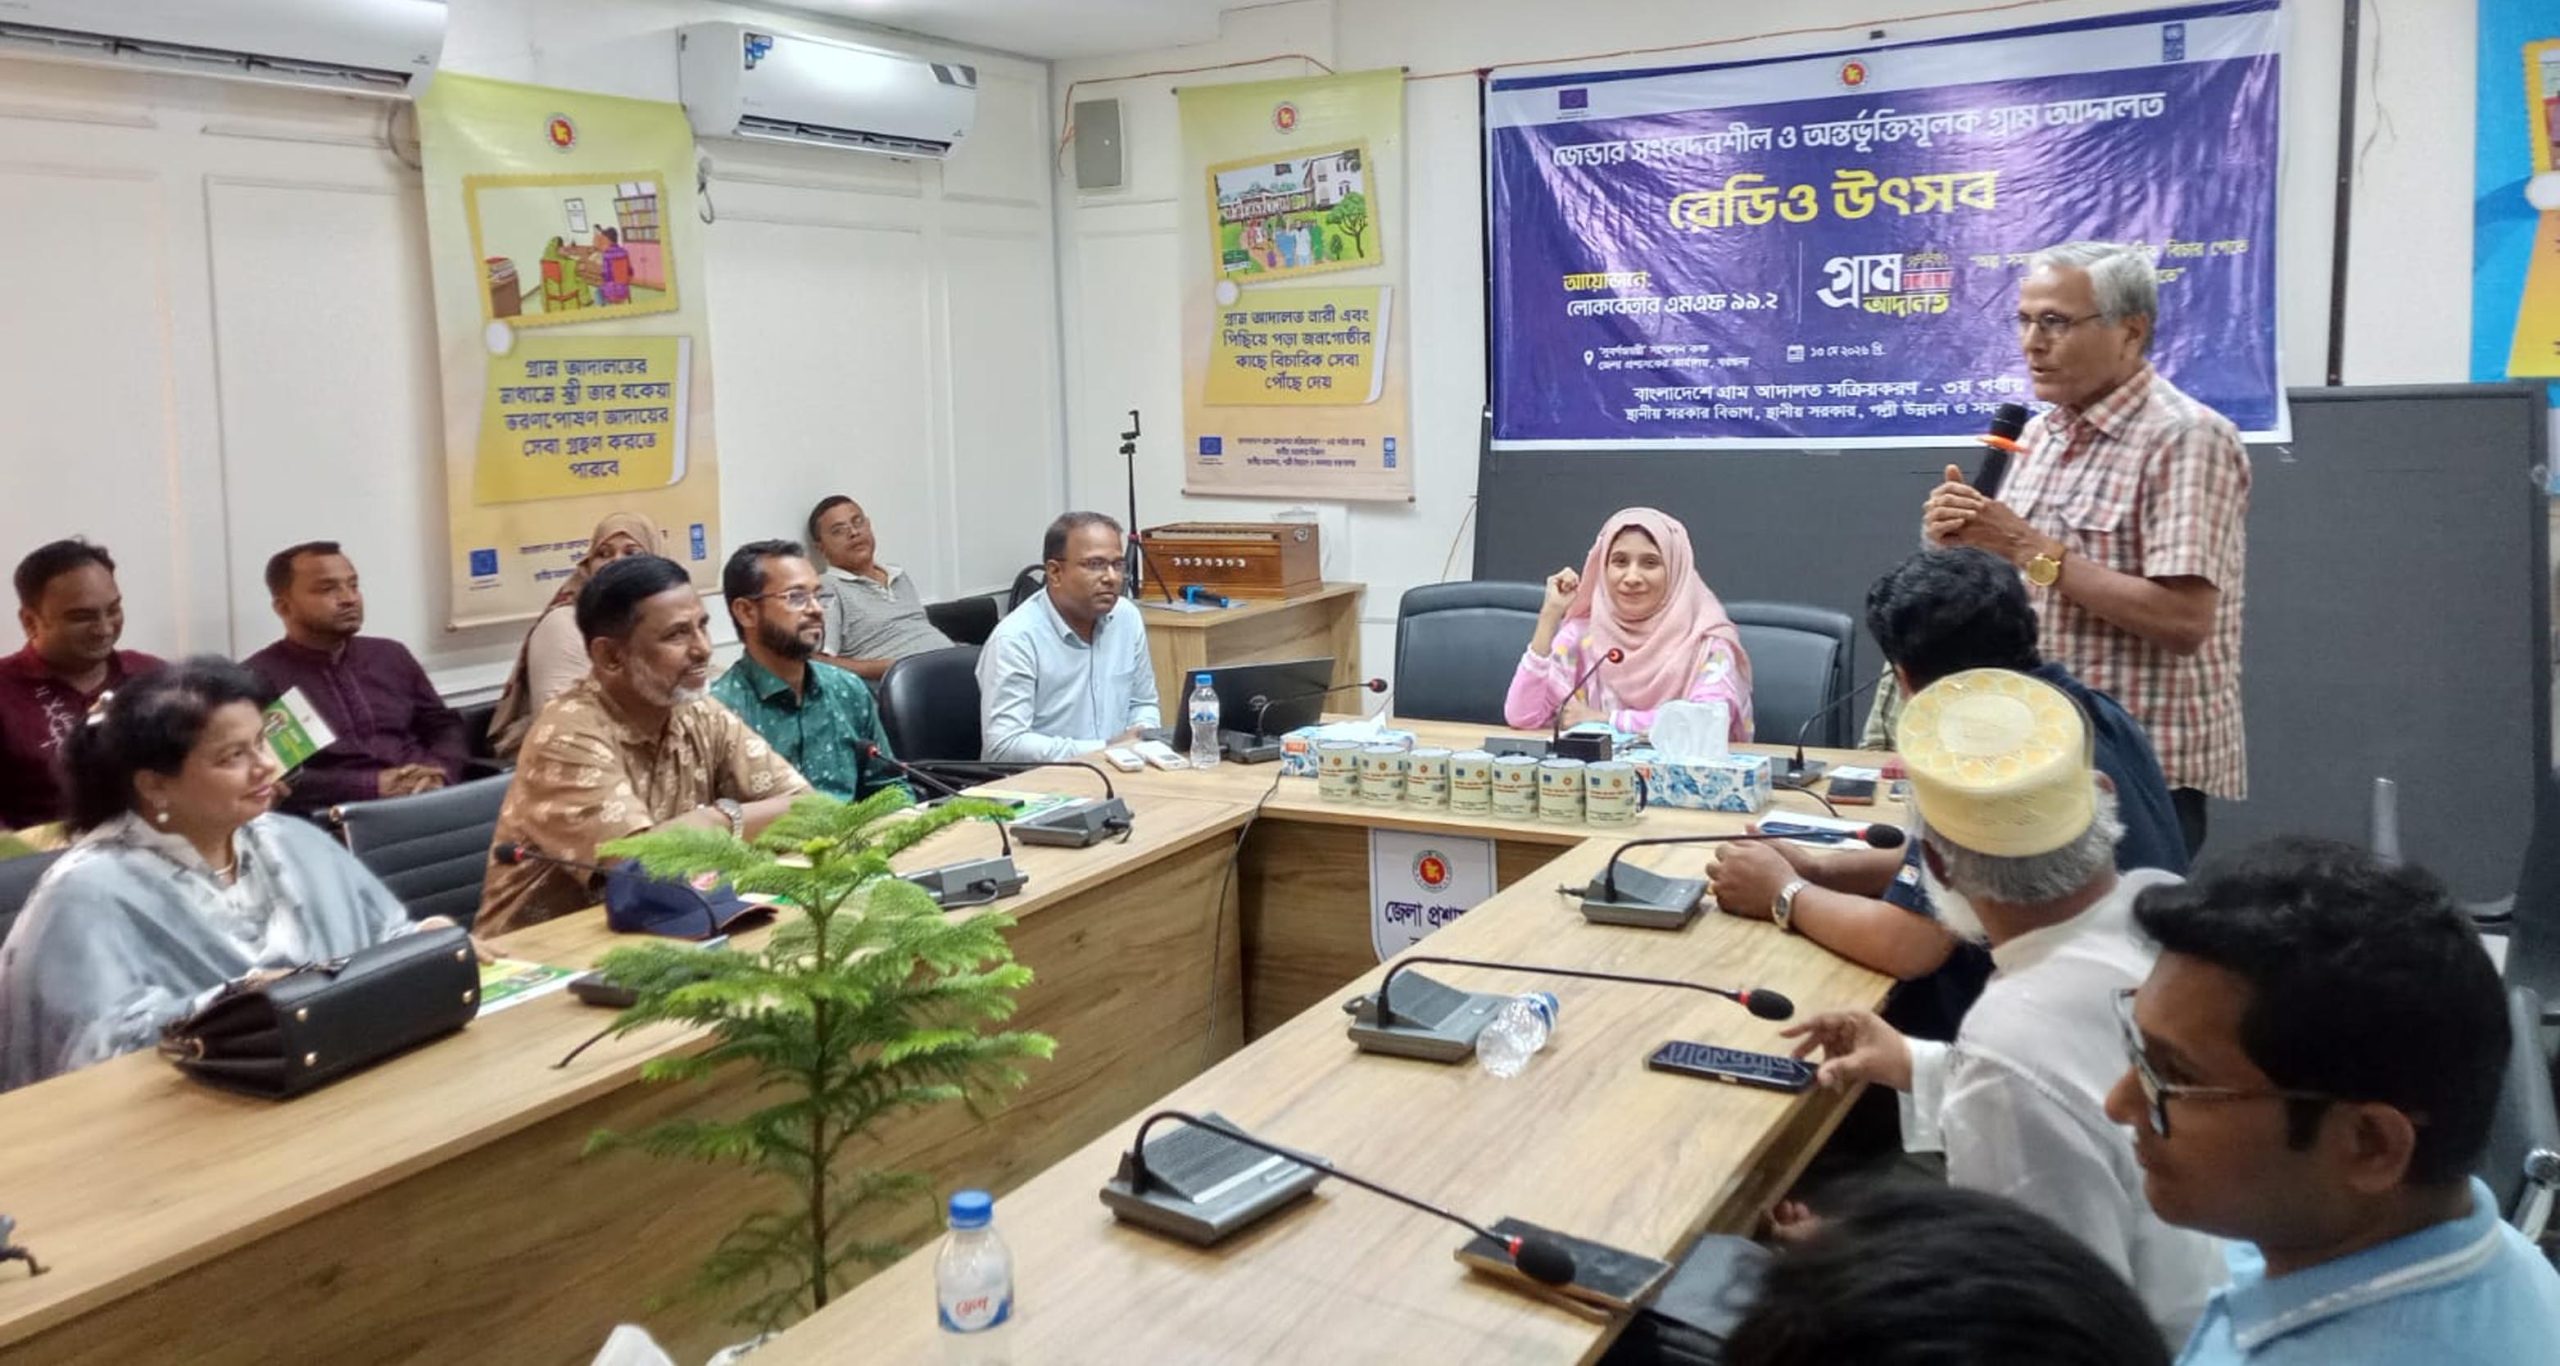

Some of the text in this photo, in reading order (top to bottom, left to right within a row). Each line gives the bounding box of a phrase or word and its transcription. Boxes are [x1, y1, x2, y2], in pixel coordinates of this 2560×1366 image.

[1553, 140, 1625, 166] জেন্ডার
[1630, 121, 1772, 161] সংবেদনশীল
[1778, 126, 1797, 148] ও
[1988, 103, 2039, 137] গ্রাম
[2044, 92, 2167, 126] আদালত
[1669, 169, 2001, 233] রেডিও উৎসব
[1563, 271, 1652, 293] আয়োজনে:
[1816, 254, 1903, 308] গ্রাম
[1252, 311, 1305, 325] আদালত
[1308, 304, 1335, 322] নারী
[1341, 309, 1369, 322] এবং
[1567, 291, 1778, 317] লোকবেতার এমএফ ৯৯.২
[1863, 292, 1951, 318] আদালত
[1223, 326, 1370, 348] পিছিয়ে পড়া জনগোষ্ঠীর
[526, 358, 648, 379] গ্রাম আদালতের
[1235, 350, 1359, 370] কাছে বিচারিক সেবা
[588, 385, 616, 401] তার
[621, 382, 671, 400] বকেয়া
[1307, 376, 1332, 389] দেয়
[1632, 385, 1713, 402] বাংলাদেশে
[1716, 385, 1749, 400] গ্রাম
[1753, 383, 1822, 399] আদালত
[1828, 378, 1921, 398] সক্রিয়করণ
[1941, 380, 1972, 395] ৩য়
[503, 407, 669, 431] ভরণপোষণ আদায়ের
[1624, 404, 1661, 422] স্থানীয়
[1665, 406, 1710, 420] সরকার
[1765, 403, 1804, 422] স্থানীয়
[1903, 400, 1948, 418] উন্নয়ন
[1954, 402, 1967, 415] ও
[523, 433, 656, 457] সেবা গ্রহণ করতে
[569, 460, 620, 479] পারবে
[1385, 901, 1423, 928] জেলা
